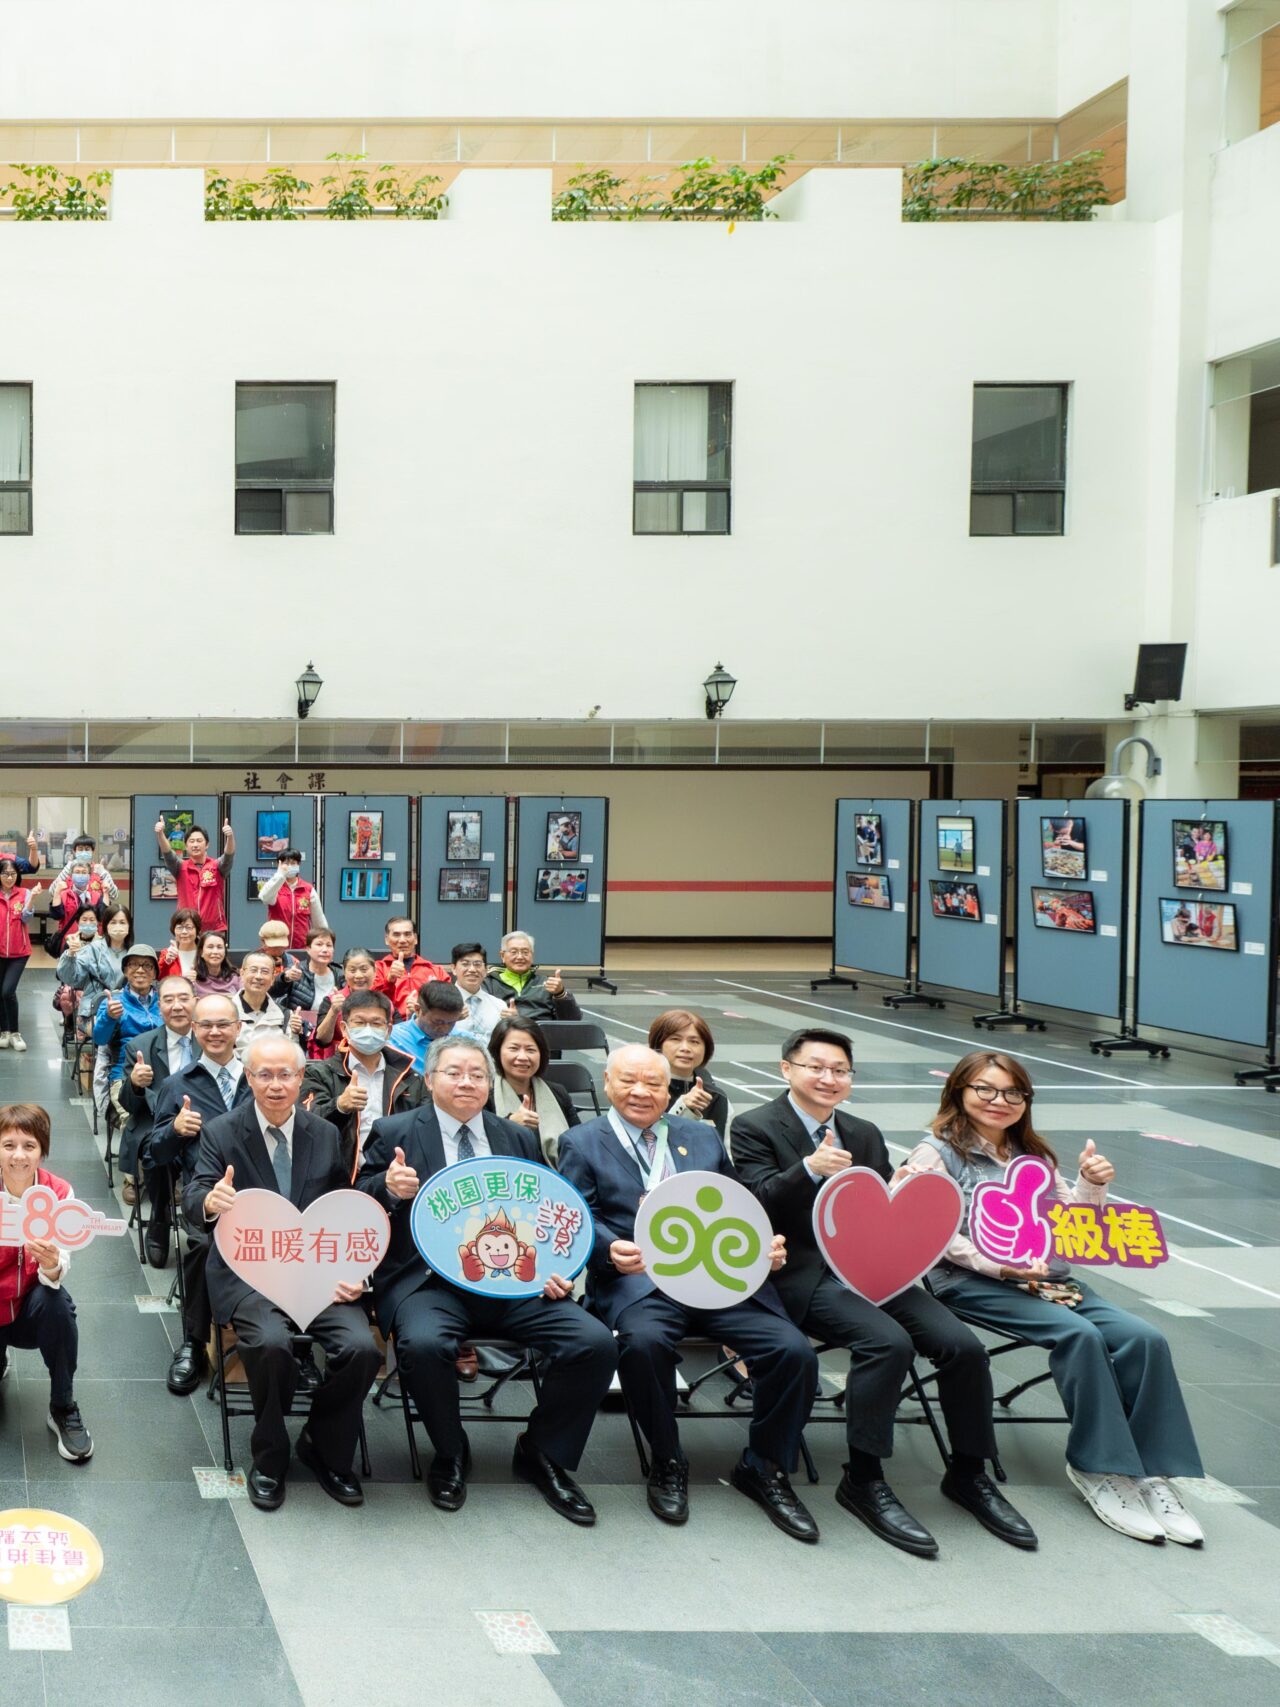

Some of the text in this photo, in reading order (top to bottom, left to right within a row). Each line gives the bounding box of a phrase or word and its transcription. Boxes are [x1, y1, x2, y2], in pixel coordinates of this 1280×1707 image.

[243, 771, 326, 791] 社會課
[81, 1223, 123, 1232] ANNIVERSARY
[426, 1171, 580, 1254] 桃園更保 讚
[233, 1227, 380, 1264] 溫暖有感
[1047, 1203, 1164, 1264] 級棒
